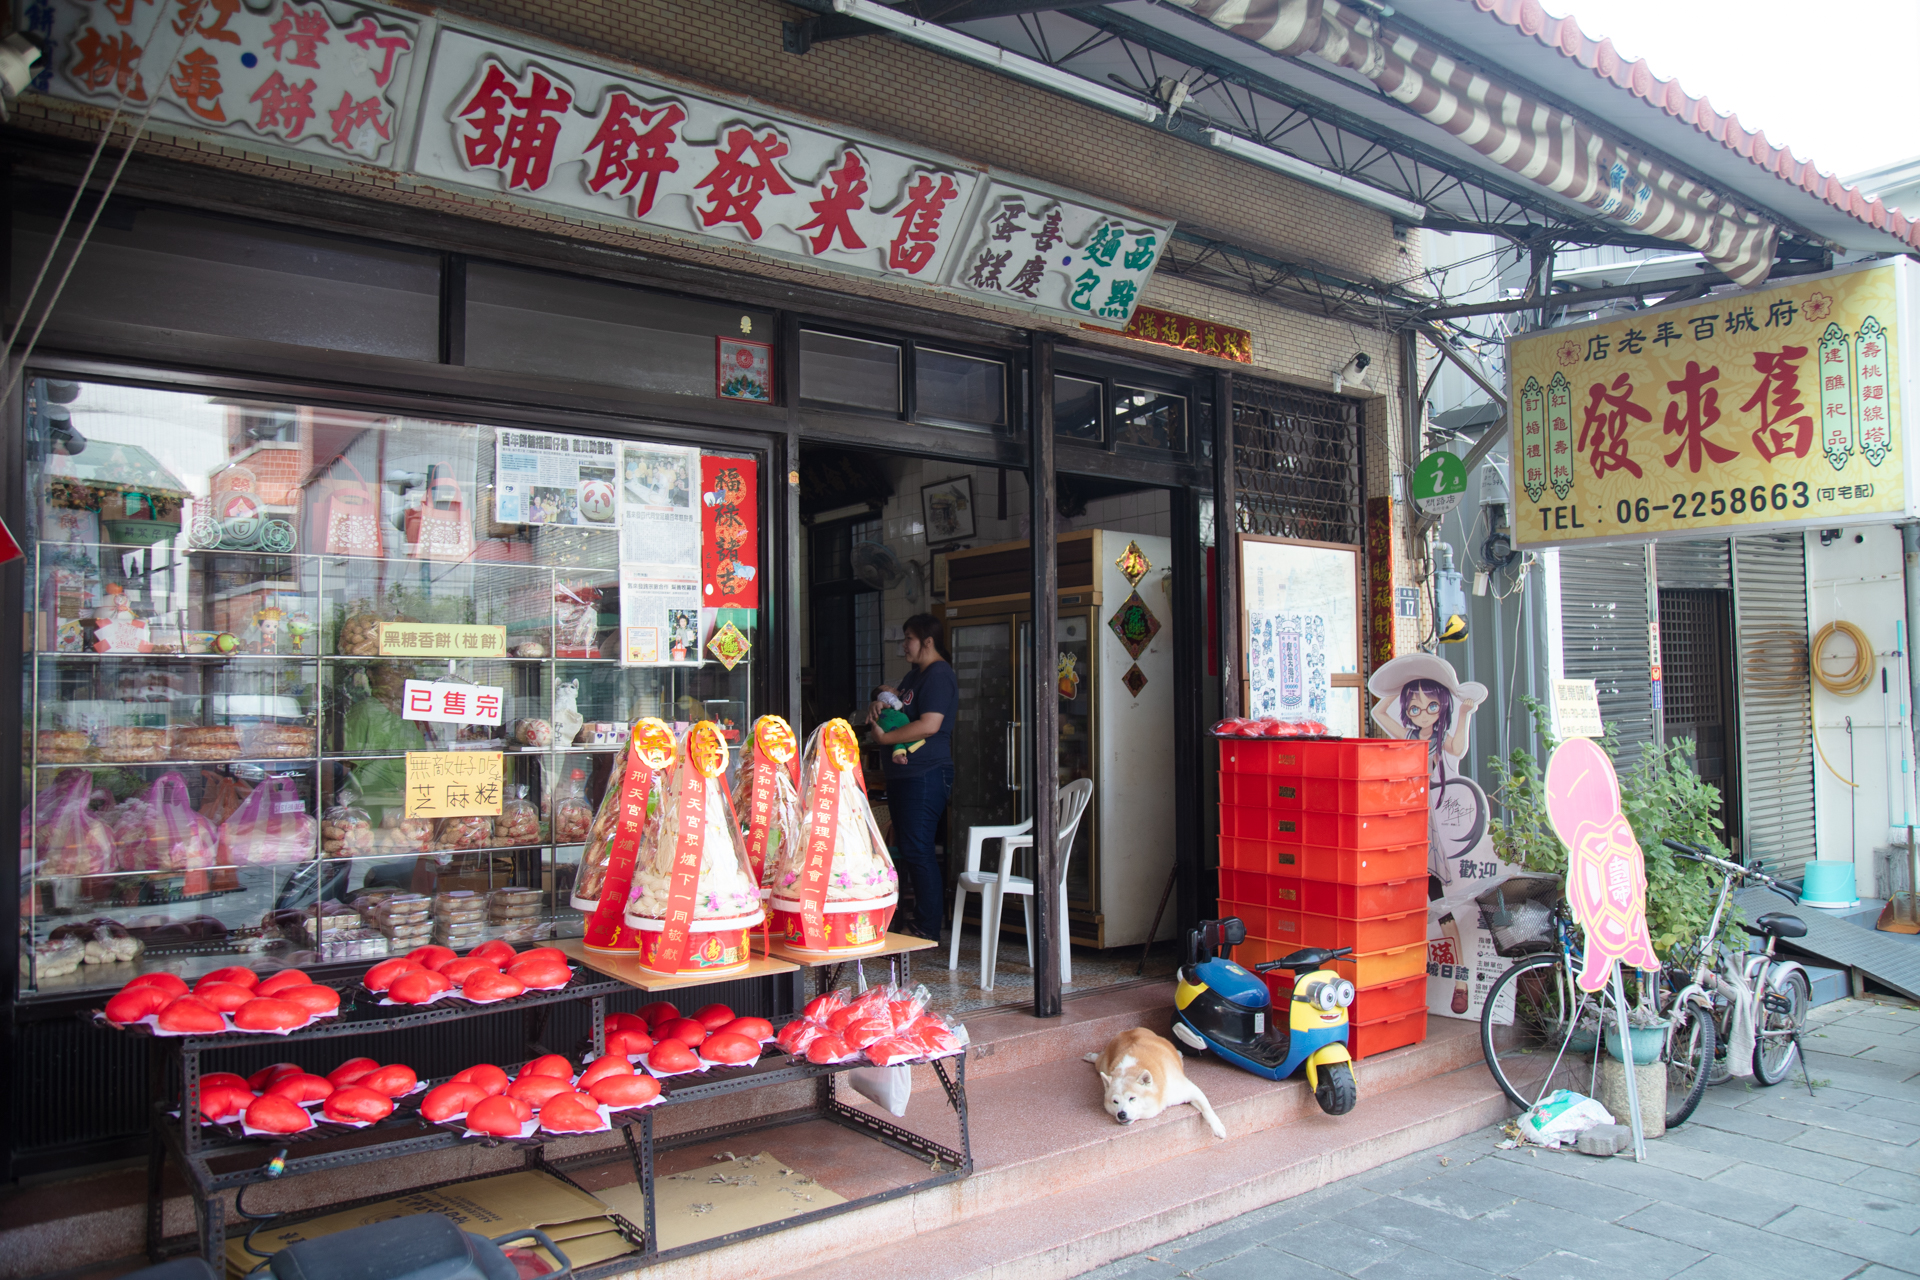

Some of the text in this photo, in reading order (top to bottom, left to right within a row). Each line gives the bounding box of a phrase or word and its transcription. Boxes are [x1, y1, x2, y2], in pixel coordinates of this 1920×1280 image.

[72, 0, 154, 101] 桃
[250, 1, 330, 138] 禮餅
[968, 204, 1027, 291] 蛋糕
[1007, 210, 1063, 298] 喜慶
[1071, 224, 1125, 310] 麵包
[1100, 236, 1156, 319] 西點
[1584, 299, 1798, 362] 府城百年老店
[1577, 345, 1814, 480] 舊來發
[1824, 348, 1847, 447] 建醮祀品
[1862, 341, 1886, 444] 壽桃麵線塔
[1525, 398, 1542, 481] 訂婚禮餅
[1550, 393, 1569, 478] 紅龜壽桃
[1616, 482, 1810, 525] 06-2258663
[1816, 483, 1875, 503] (可宅配)
[384, 631, 505, 650] 黑糖香餅(椪餅)
[1405, 600, 1415, 615] 17
[410, 689, 499, 718] 已售完
[410, 754, 500, 780] 無敵好吃
[803, 770, 836, 939] 元和宮管理委員會一同敬獻
[1459, 859, 1497, 879] 歡迎
[1608, 856, 1631, 907] 壽
